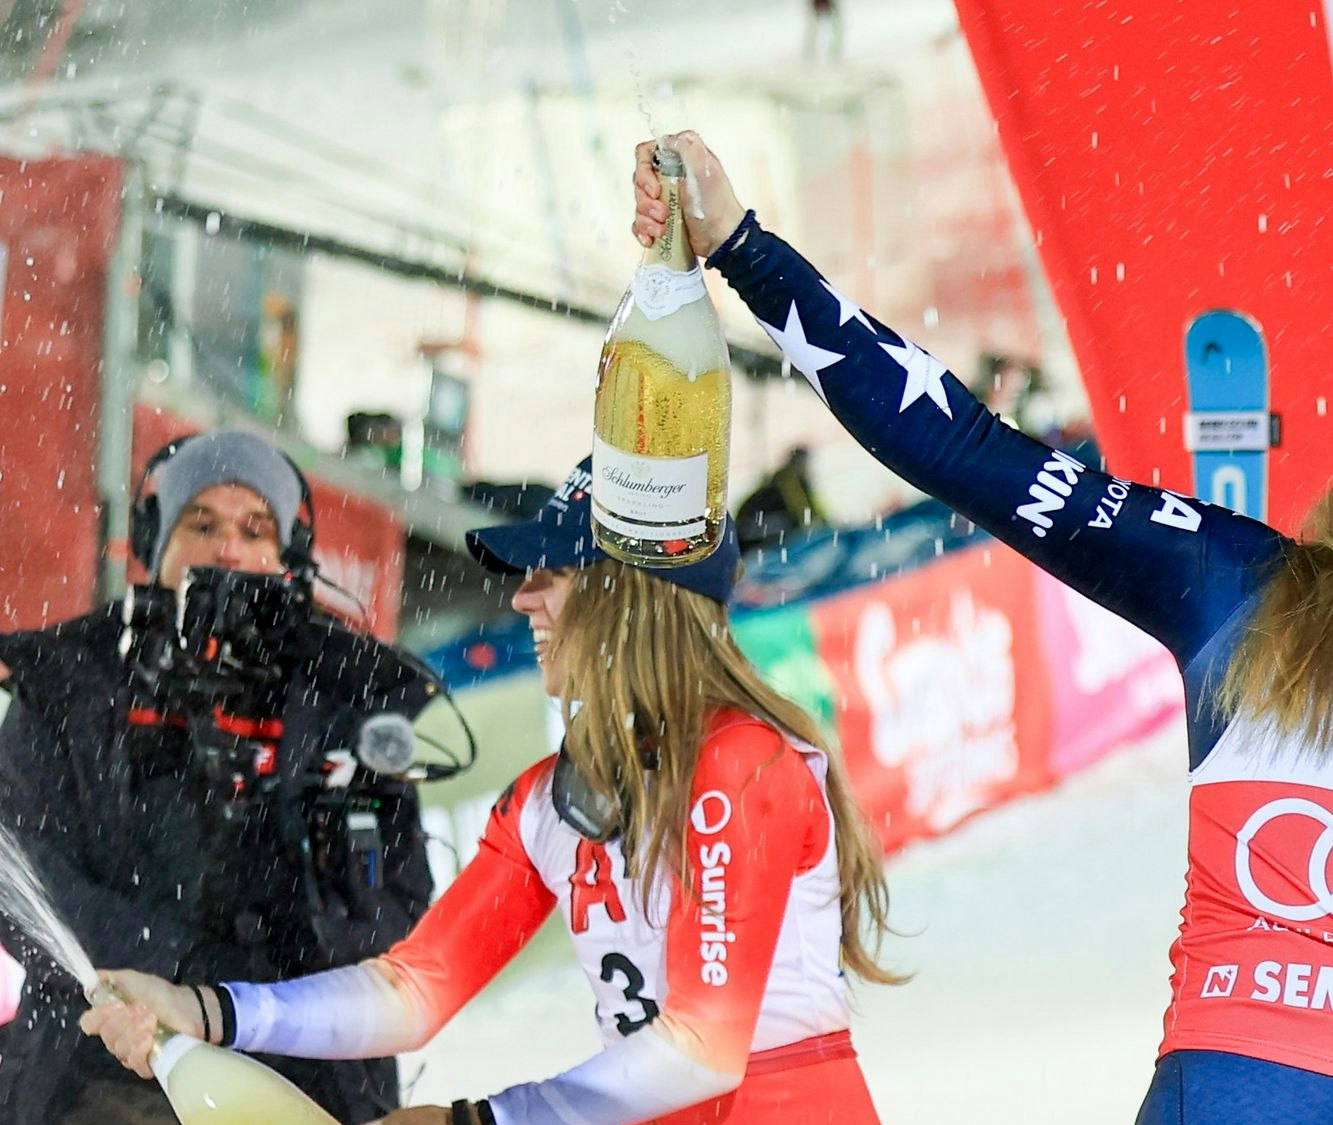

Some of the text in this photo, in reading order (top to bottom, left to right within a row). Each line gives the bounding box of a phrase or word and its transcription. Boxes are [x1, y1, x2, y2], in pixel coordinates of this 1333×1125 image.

[602, 465, 687, 498] Schlumberger
[700, 841, 736, 987] Sunrise
[600, 953, 660, 1037] 3
